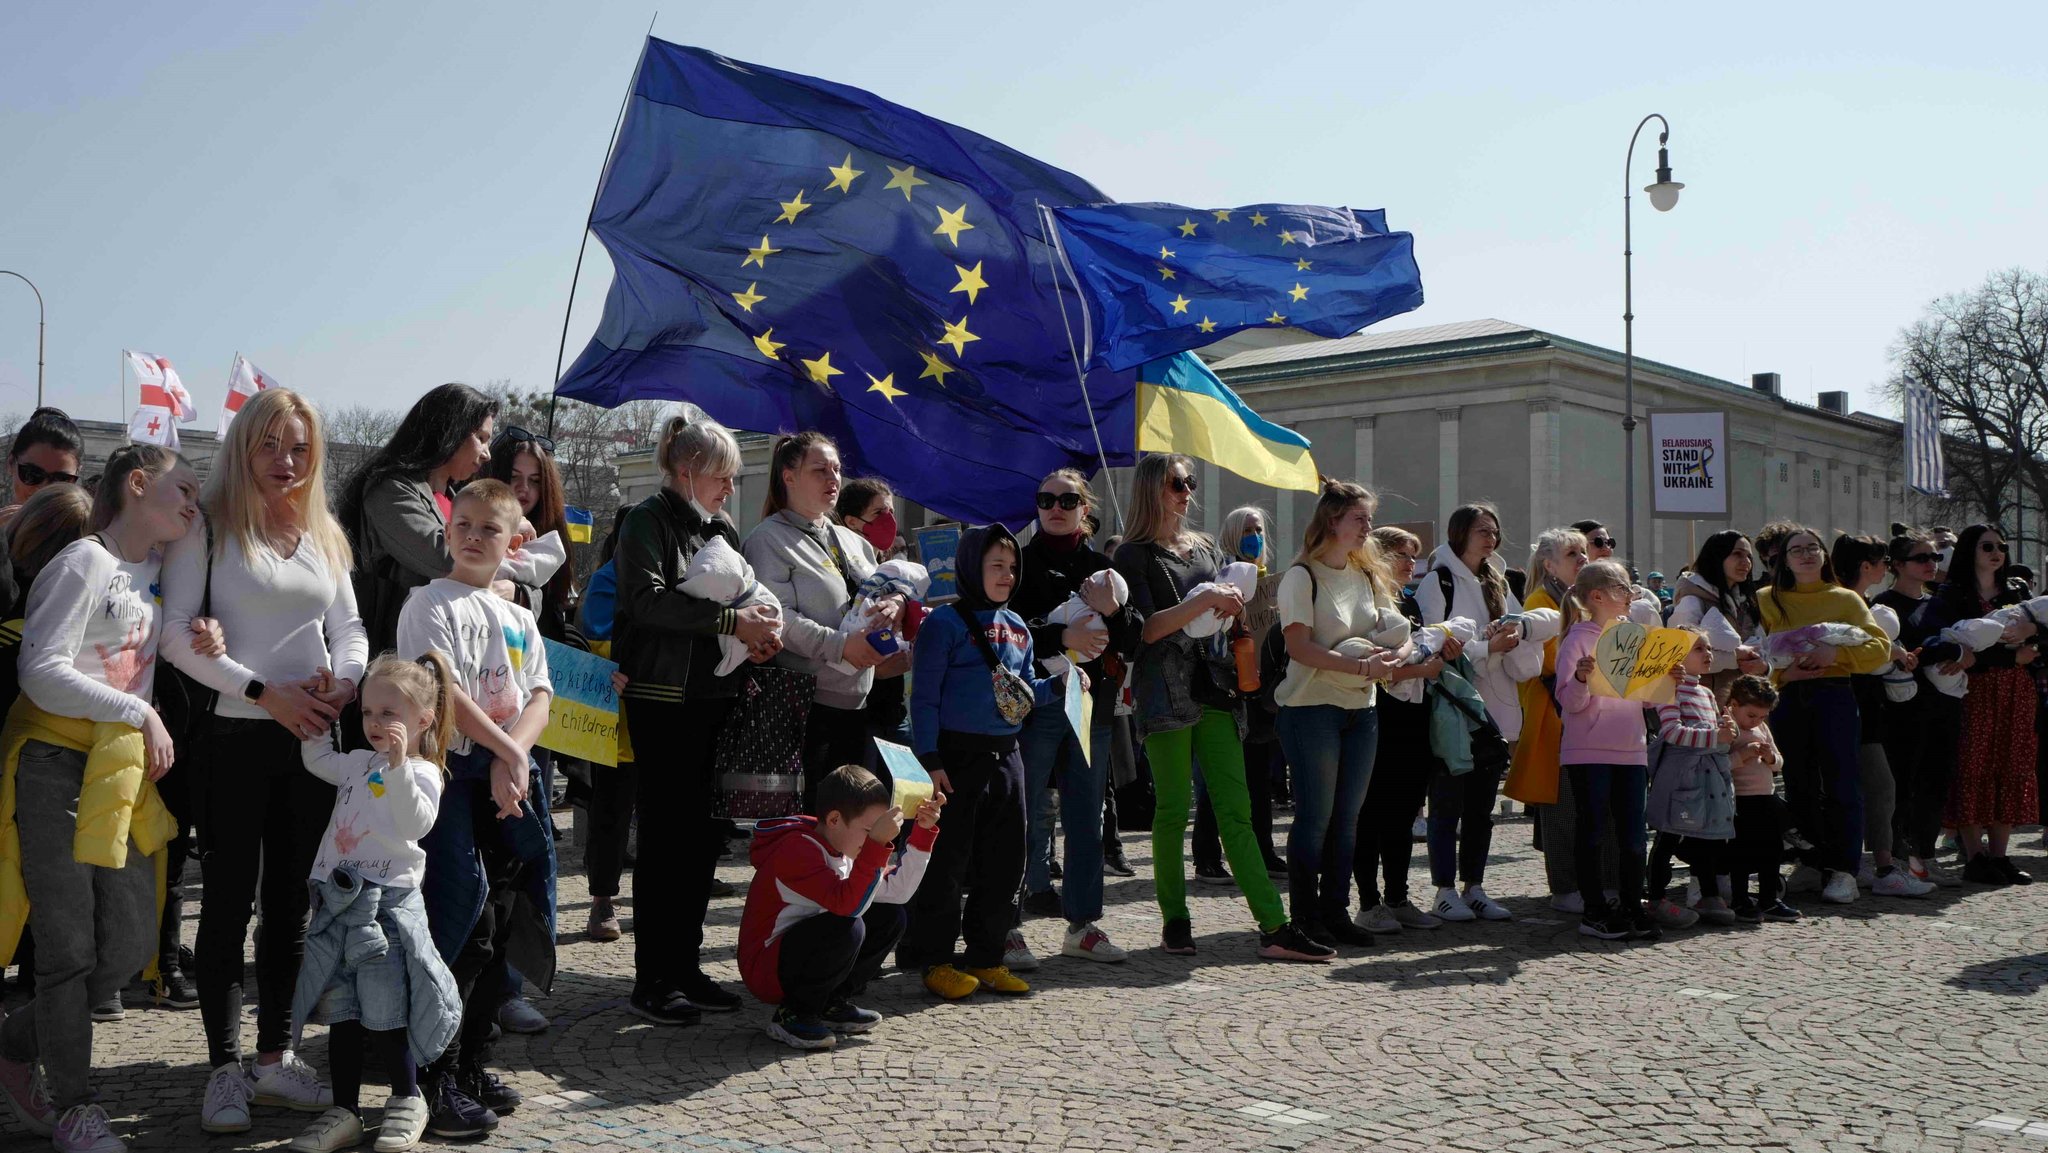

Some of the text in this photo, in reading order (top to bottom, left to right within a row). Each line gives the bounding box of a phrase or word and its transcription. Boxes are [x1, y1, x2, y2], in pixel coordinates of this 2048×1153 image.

[1661, 439, 1713, 448] BELARUSIANS
[1662, 449, 1699, 461] STAND
[1662, 463, 1691, 474] WITH
[1663, 476, 1714, 488] UKRAINE
[1001, 629, 1025, 643] PLAY
[1616, 630, 1646, 662] WAR
[561, 708, 619, 741] children!
